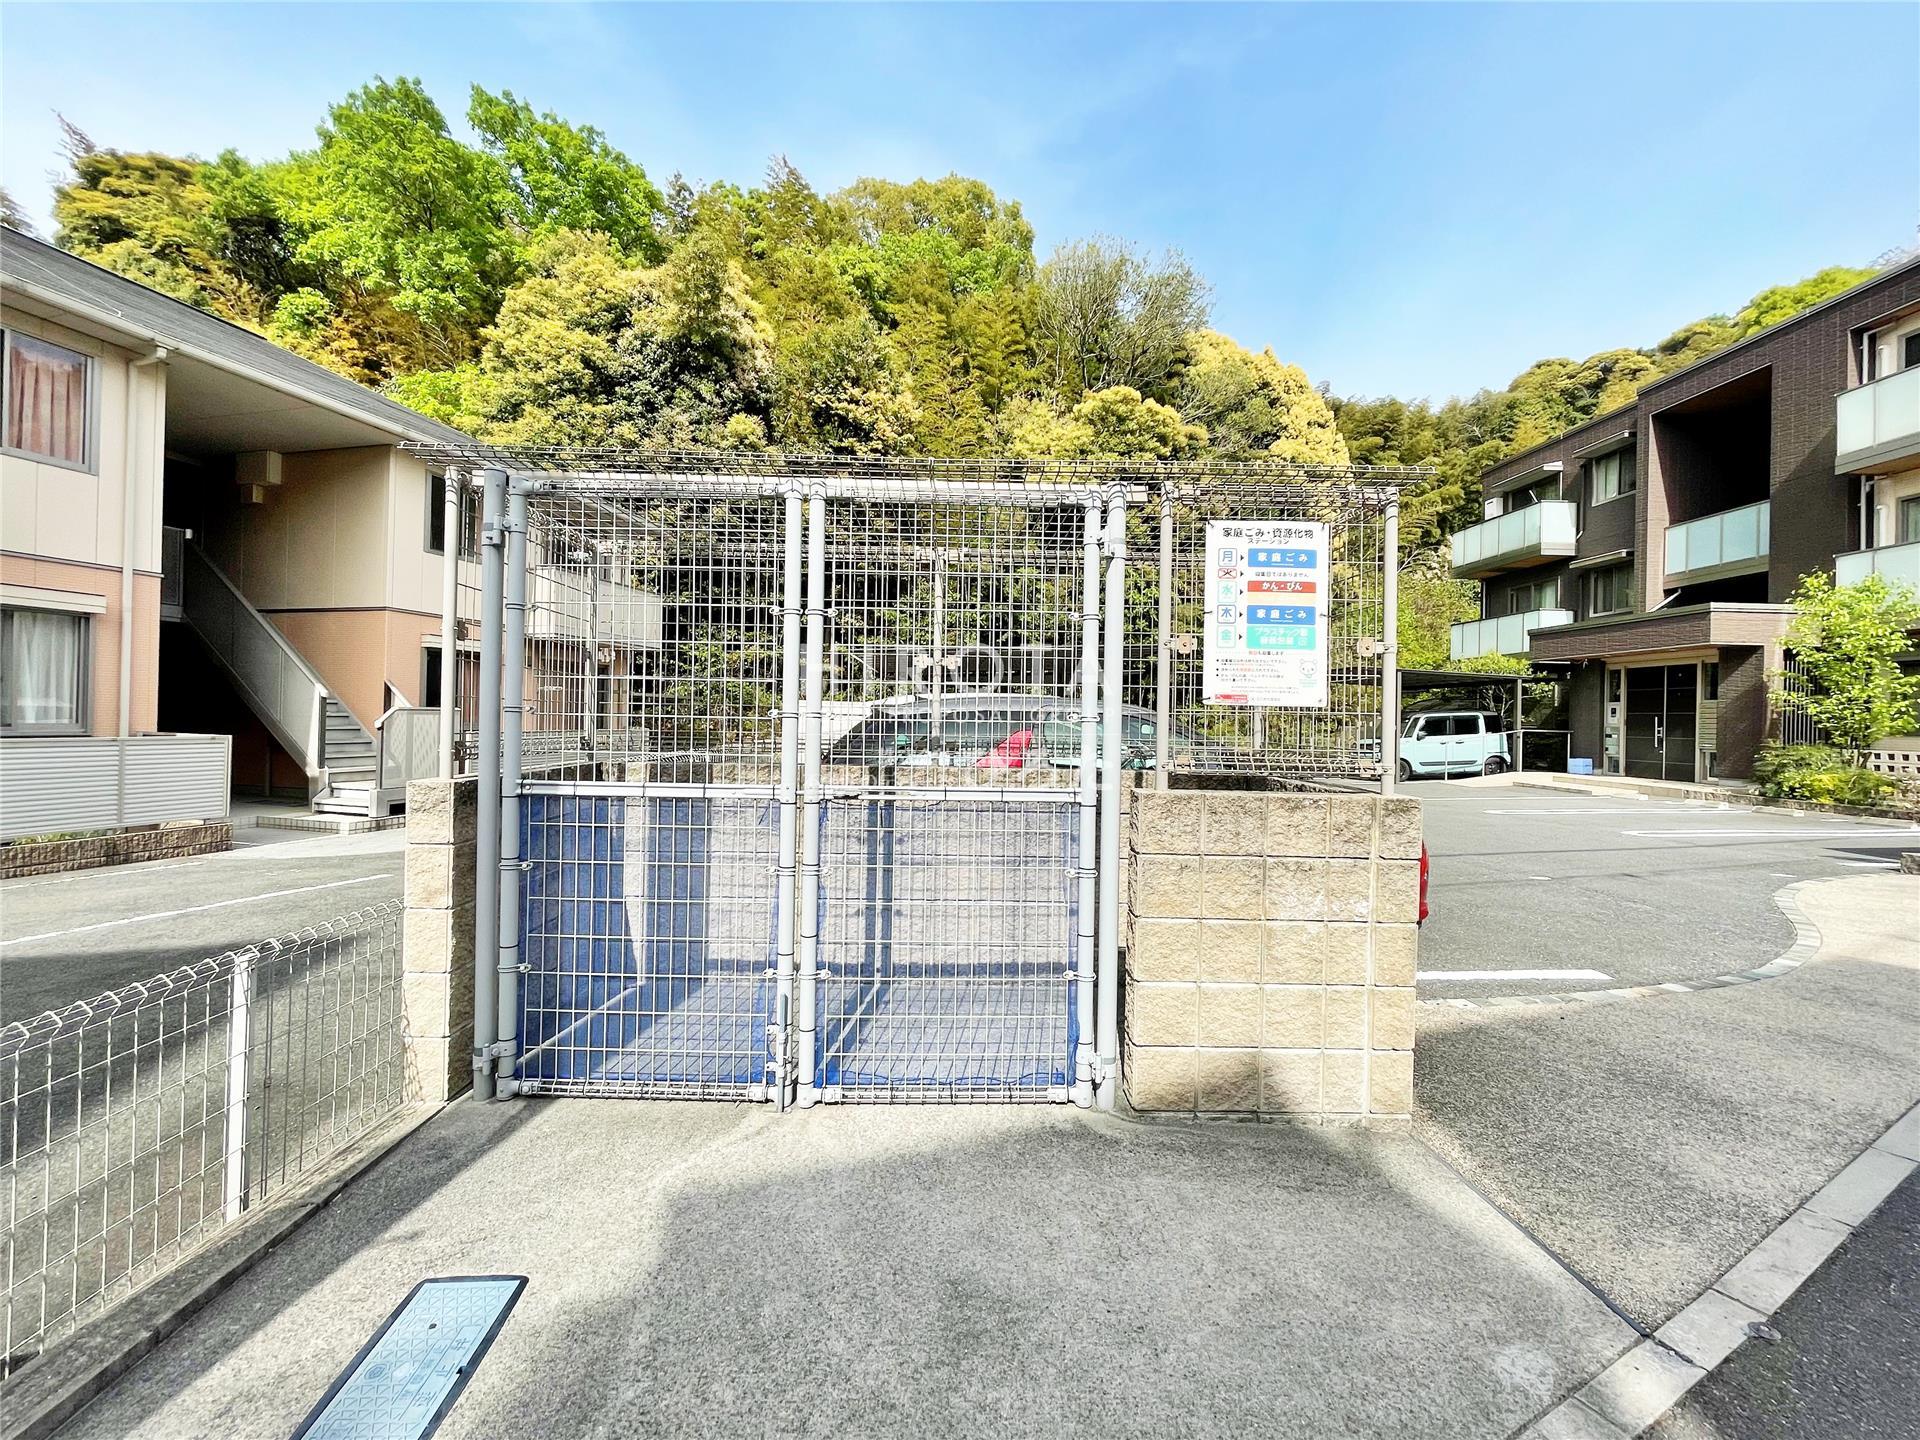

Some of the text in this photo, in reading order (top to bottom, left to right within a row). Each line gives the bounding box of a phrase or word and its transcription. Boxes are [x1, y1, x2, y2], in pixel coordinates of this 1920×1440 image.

[1222, 527, 1314, 539] 家庭ごみ・資源化物
[1222, 550, 1233, 562] 月
[1257, 552, 1308, 563] 家庭ごみ
[1222, 568, 1233, 576] 火
[1222, 584, 1233, 596] 水
[1262, 582, 1303, 590] かん・びん
[1221, 607, 1232, 618] 木
[1256, 608, 1307, 619] 家庭ごみ
[1221, 629, 1232, 640] 金
